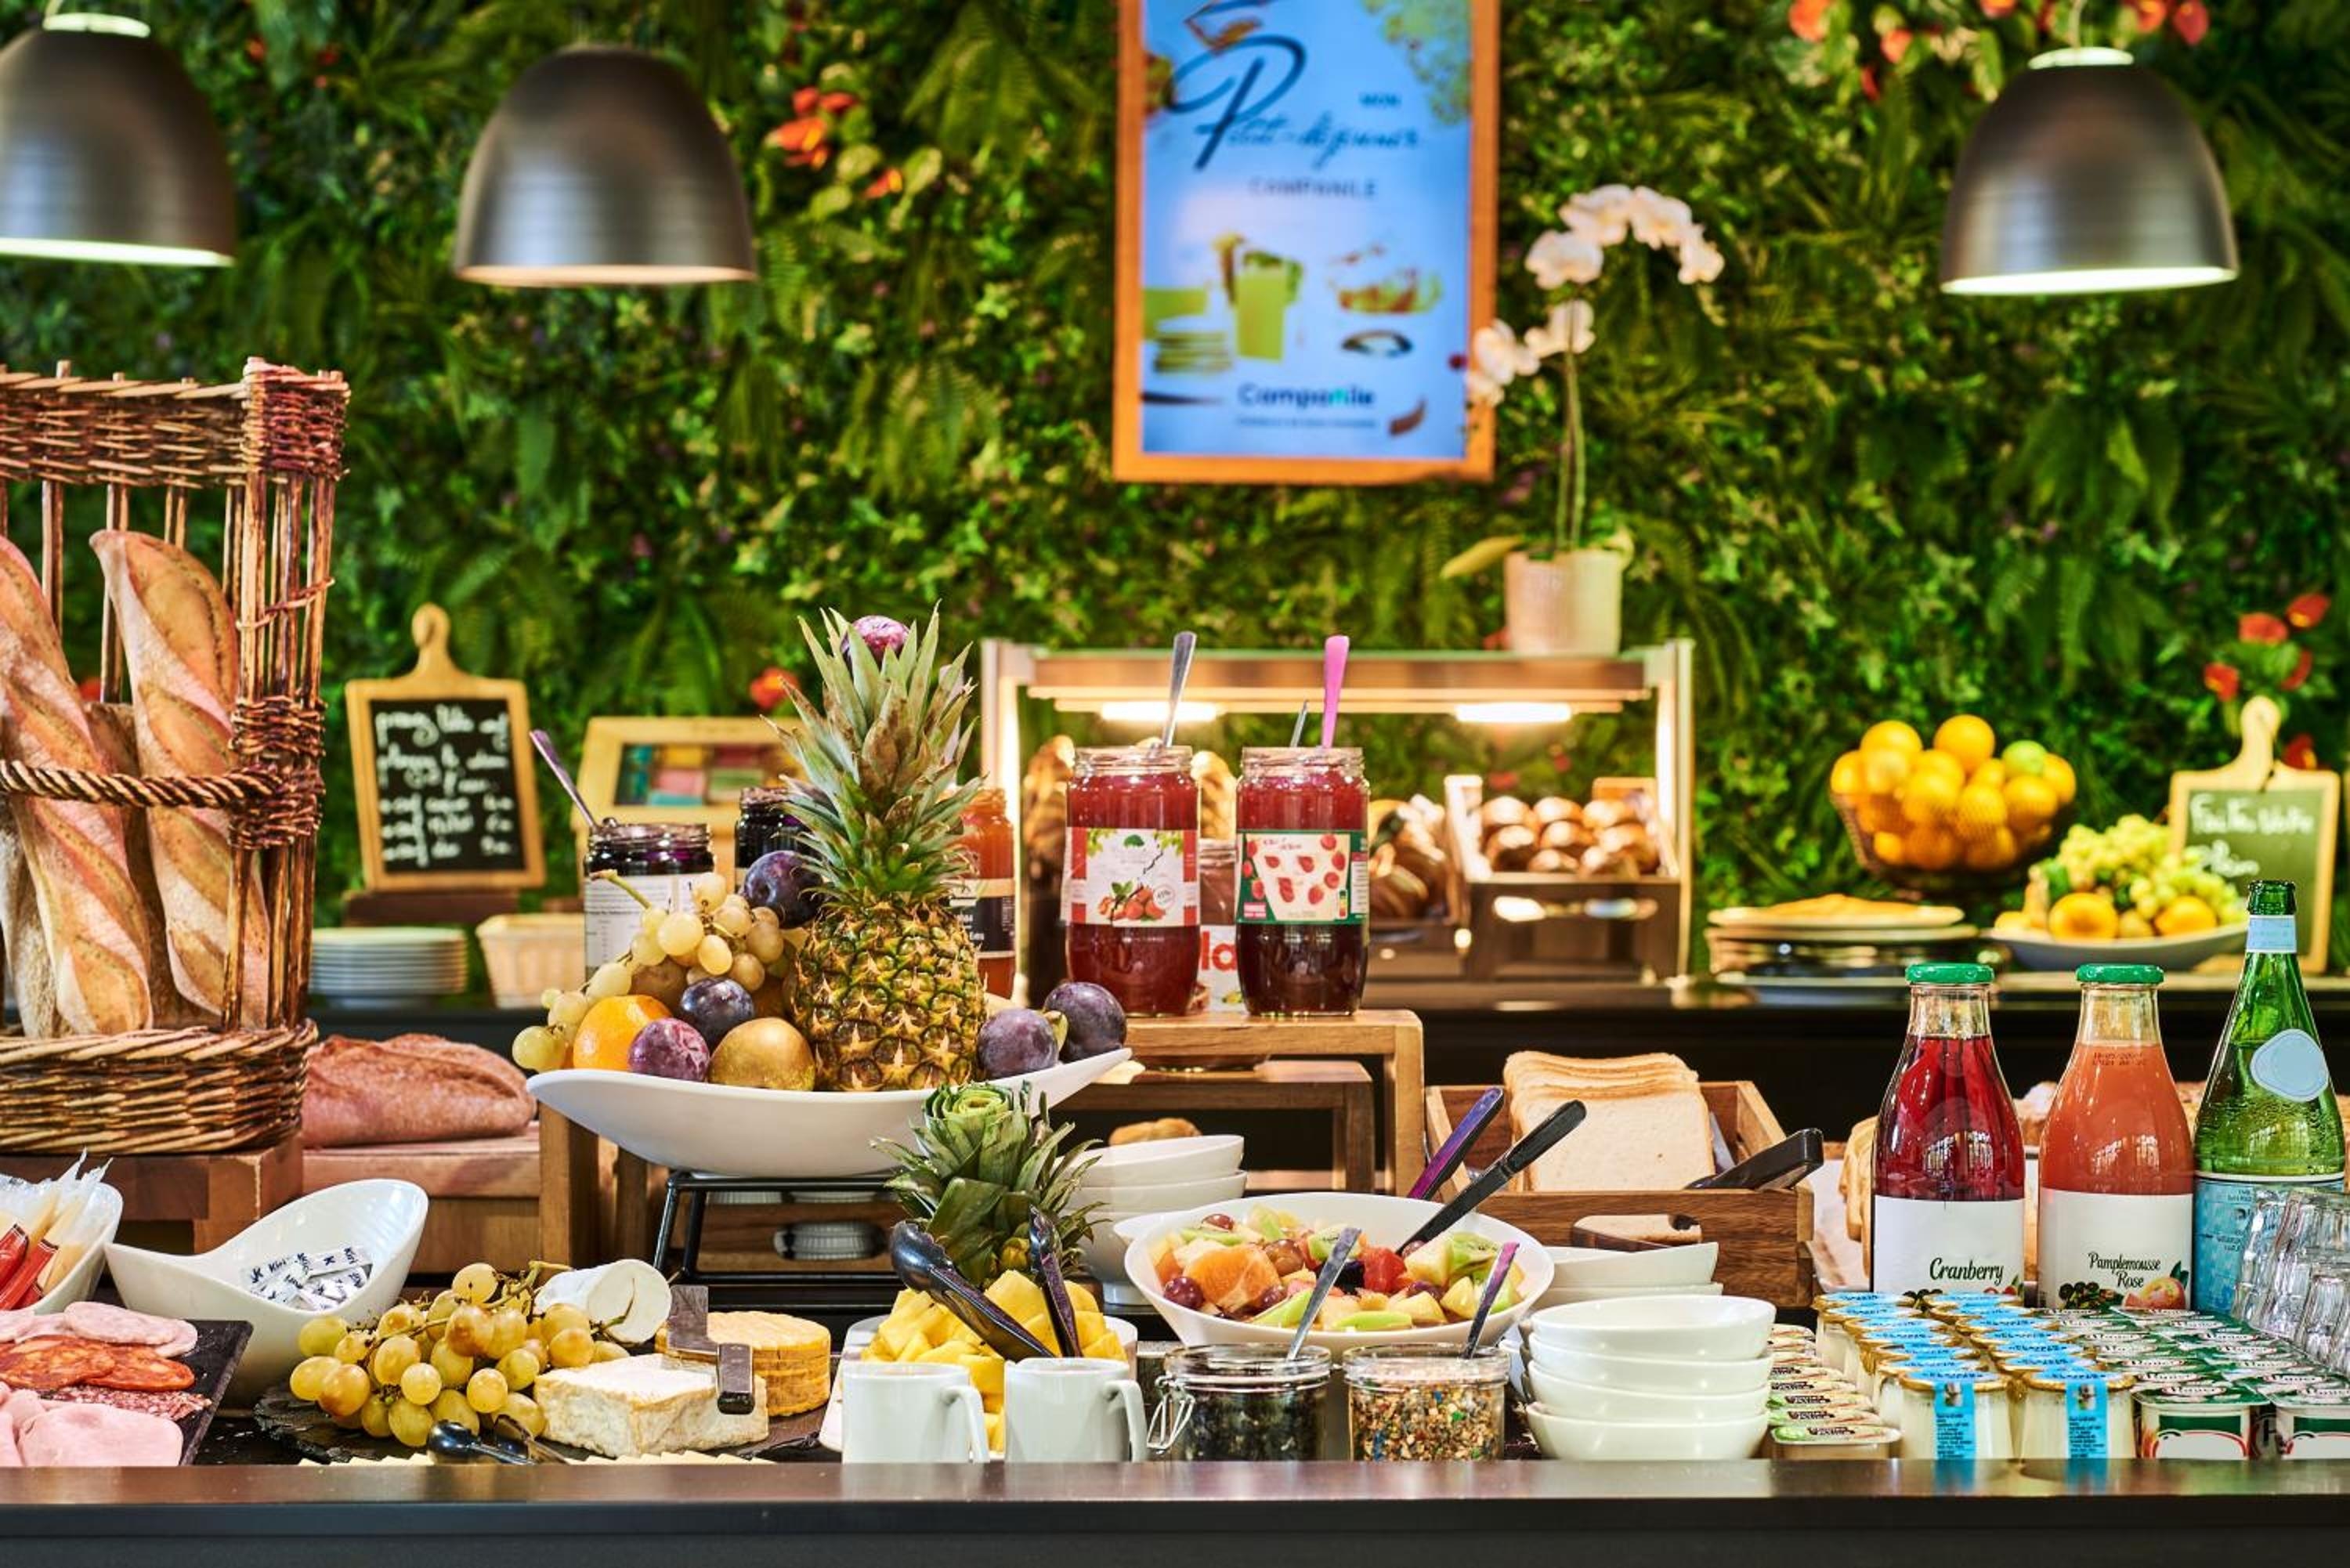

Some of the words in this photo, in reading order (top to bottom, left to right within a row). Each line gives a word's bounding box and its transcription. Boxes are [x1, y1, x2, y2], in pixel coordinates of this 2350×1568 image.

[1929, 1257, 2005, 1287] Cranberry
[2088, 1251, 2162, 1276] Pamplemousse
[2115, 1270, 2145, 1289] Rose
